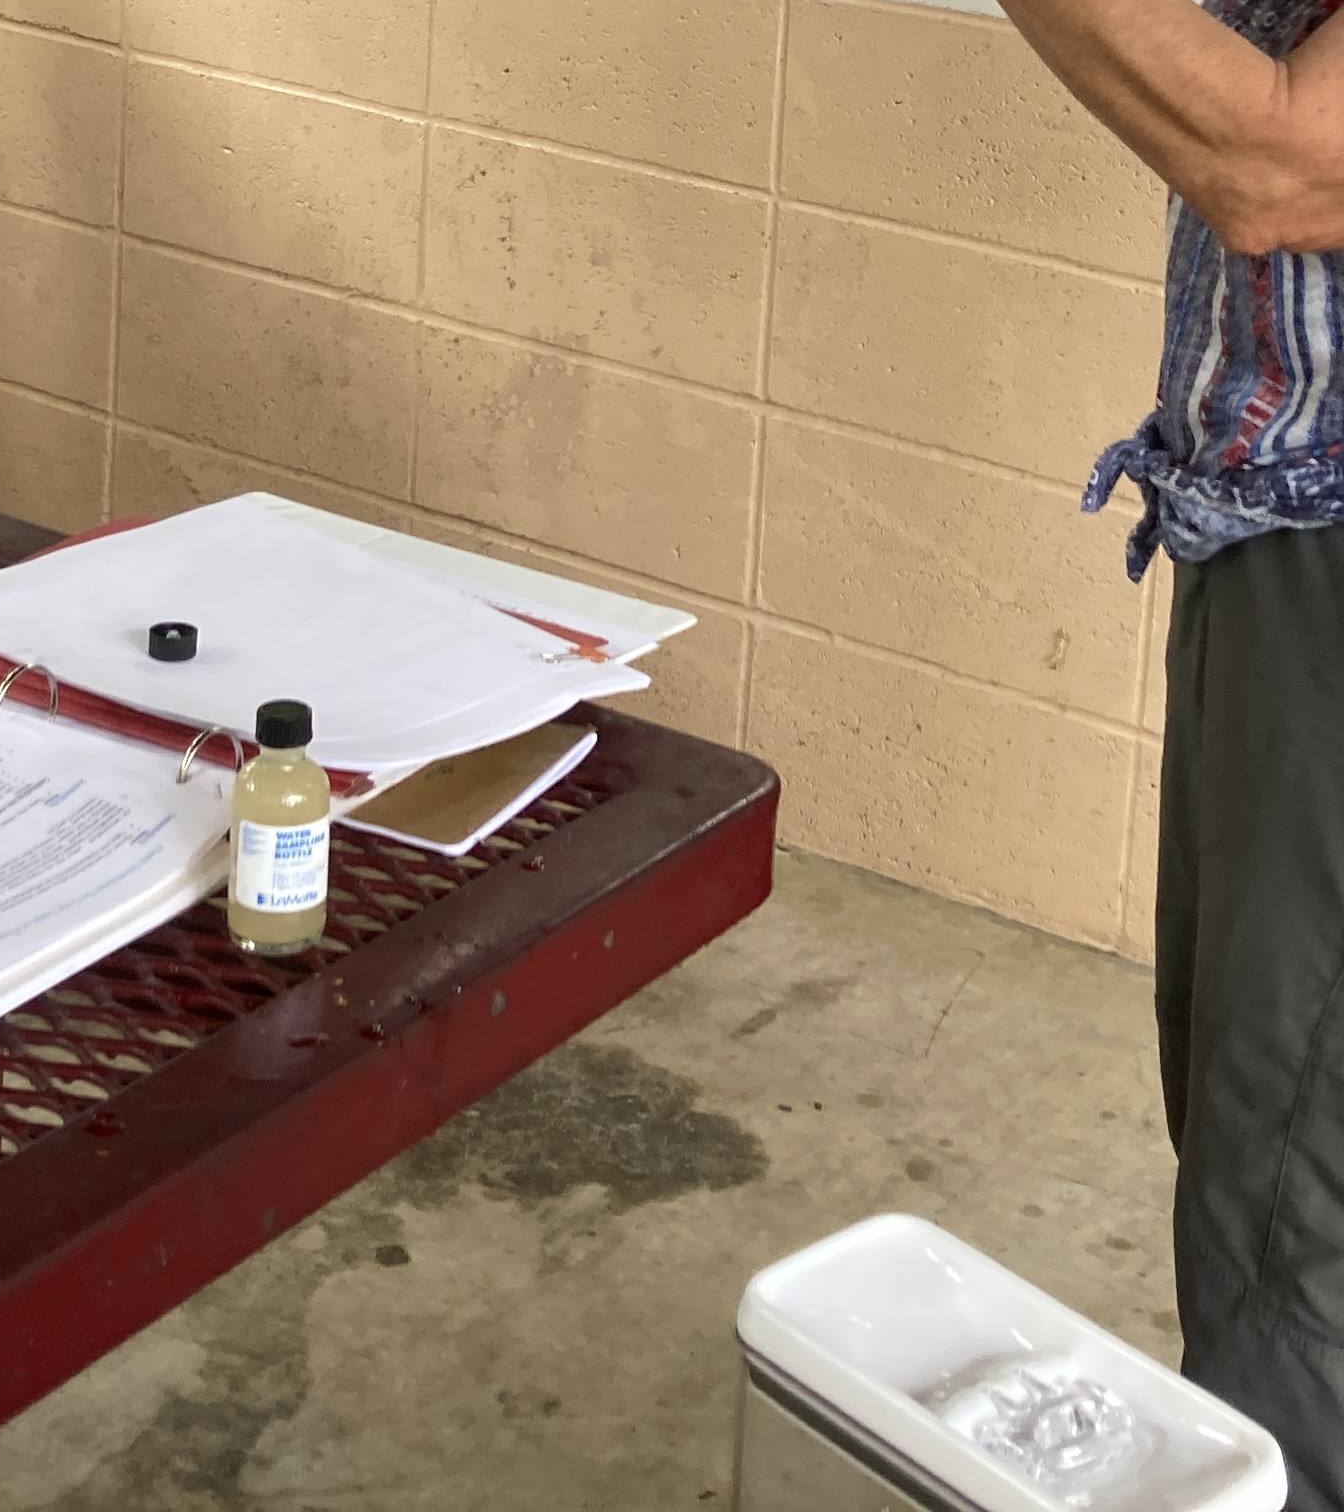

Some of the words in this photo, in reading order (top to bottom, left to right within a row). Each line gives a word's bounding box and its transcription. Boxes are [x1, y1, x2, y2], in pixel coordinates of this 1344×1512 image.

[275, 831, 325, 849] SAMPLING
[276, 829, 311, 839] WATER
[275, 847, 312, 859] BOTTLE
